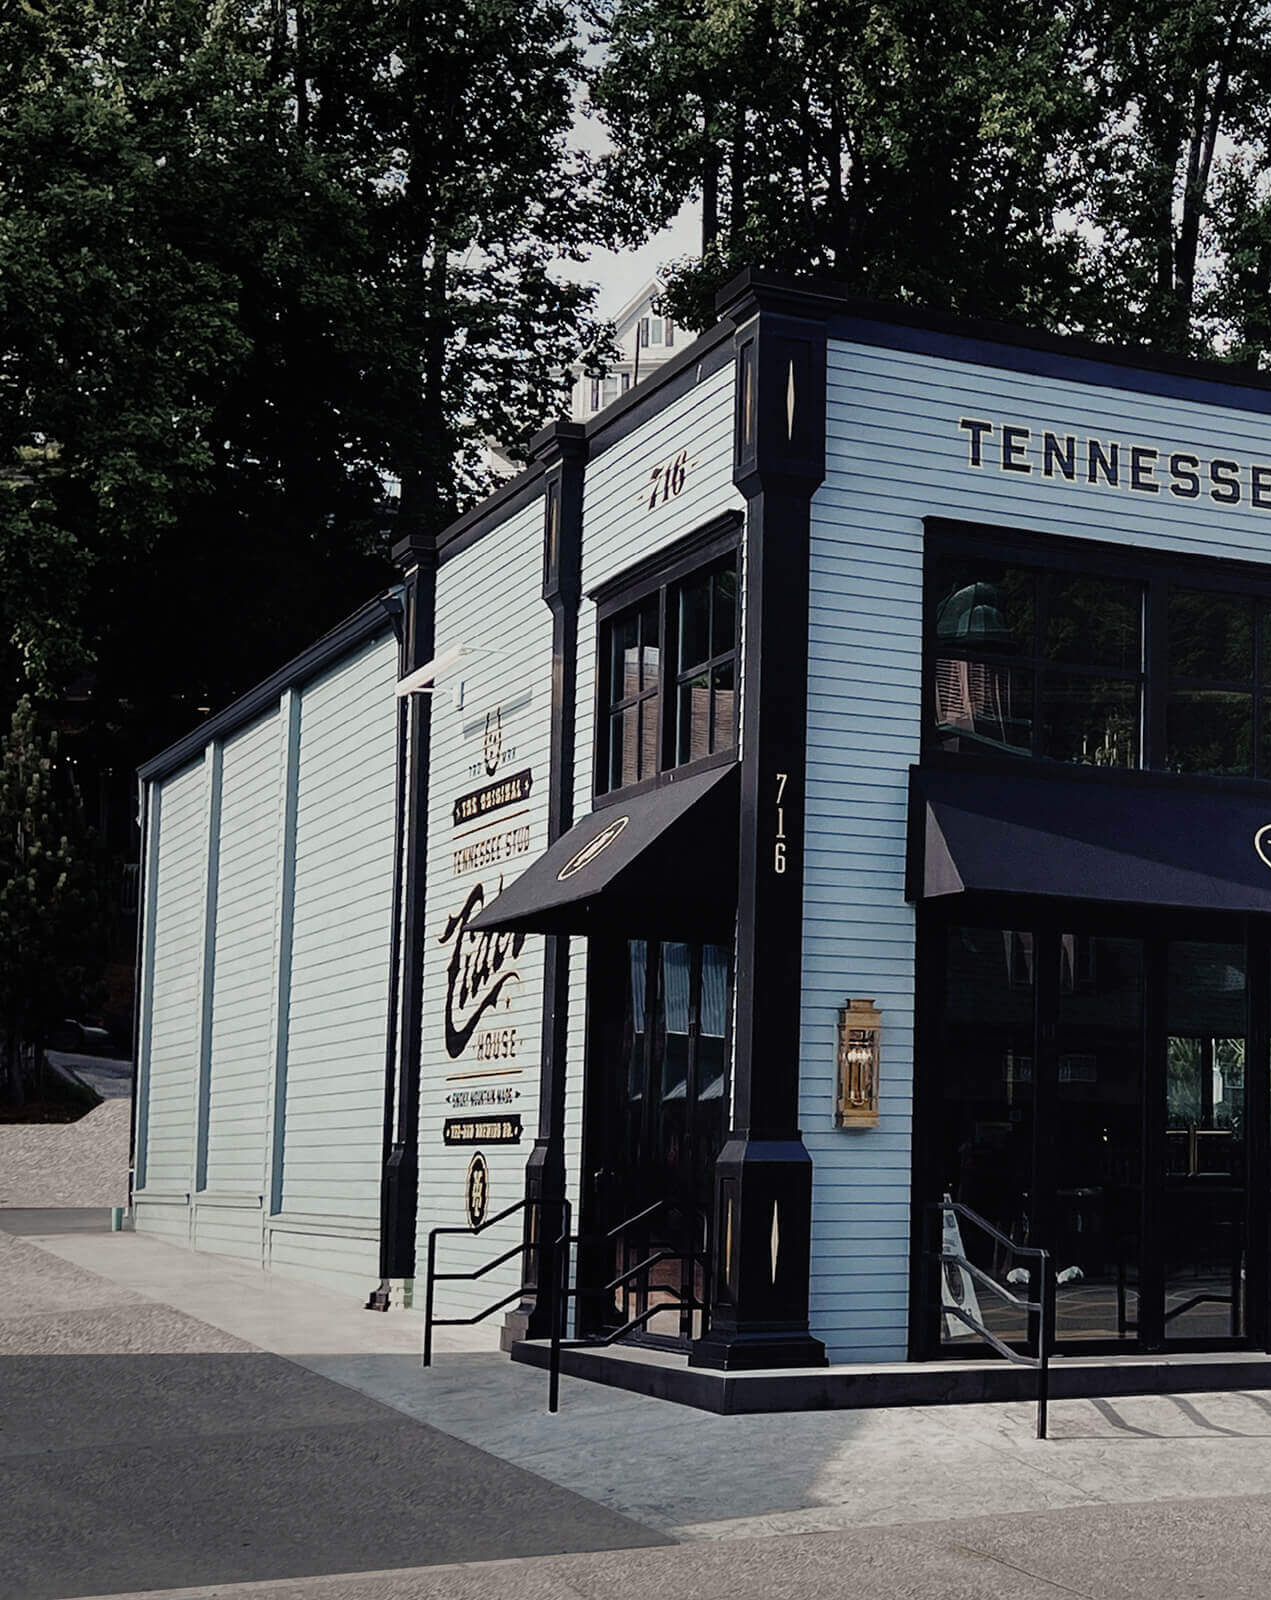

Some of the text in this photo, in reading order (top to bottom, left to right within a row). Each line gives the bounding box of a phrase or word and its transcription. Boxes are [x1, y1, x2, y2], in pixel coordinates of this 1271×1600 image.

[648, 450, 687, 511] 716
[480, 779, 521, 810] ORIGINAL
[775, 773, 787, 873] 716
[453, 825, 530, 874] TENNESSEE STUD
[476, 1029, 517, 1061] HOUSE
